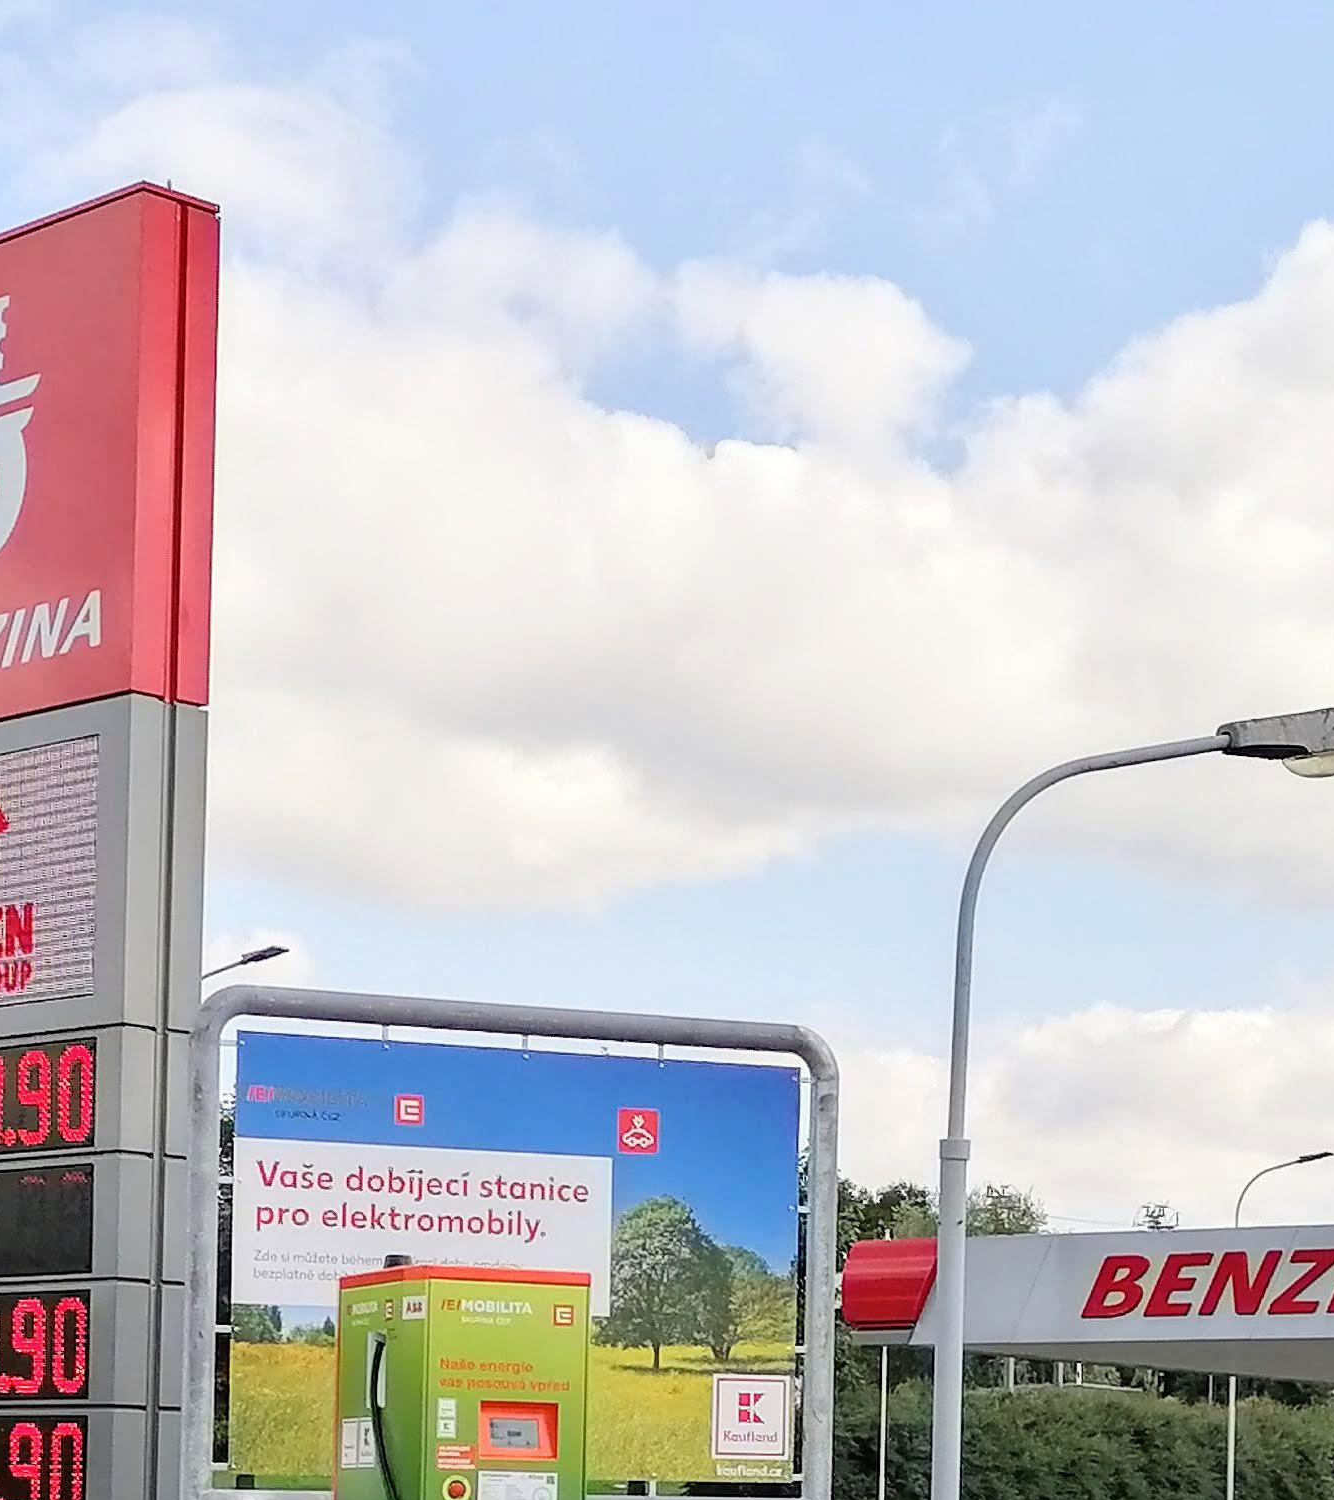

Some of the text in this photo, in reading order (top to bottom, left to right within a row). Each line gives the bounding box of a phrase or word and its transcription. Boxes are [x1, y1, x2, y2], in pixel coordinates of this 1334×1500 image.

[257, 1159, 590, 1202] Vaše dobíjecí stanice
[256, 1202, 547, 1243] pro elektromobily.
[253, 1250, 277, 1262] Zde
[723, 1430, 778, 1443] Kaufland
